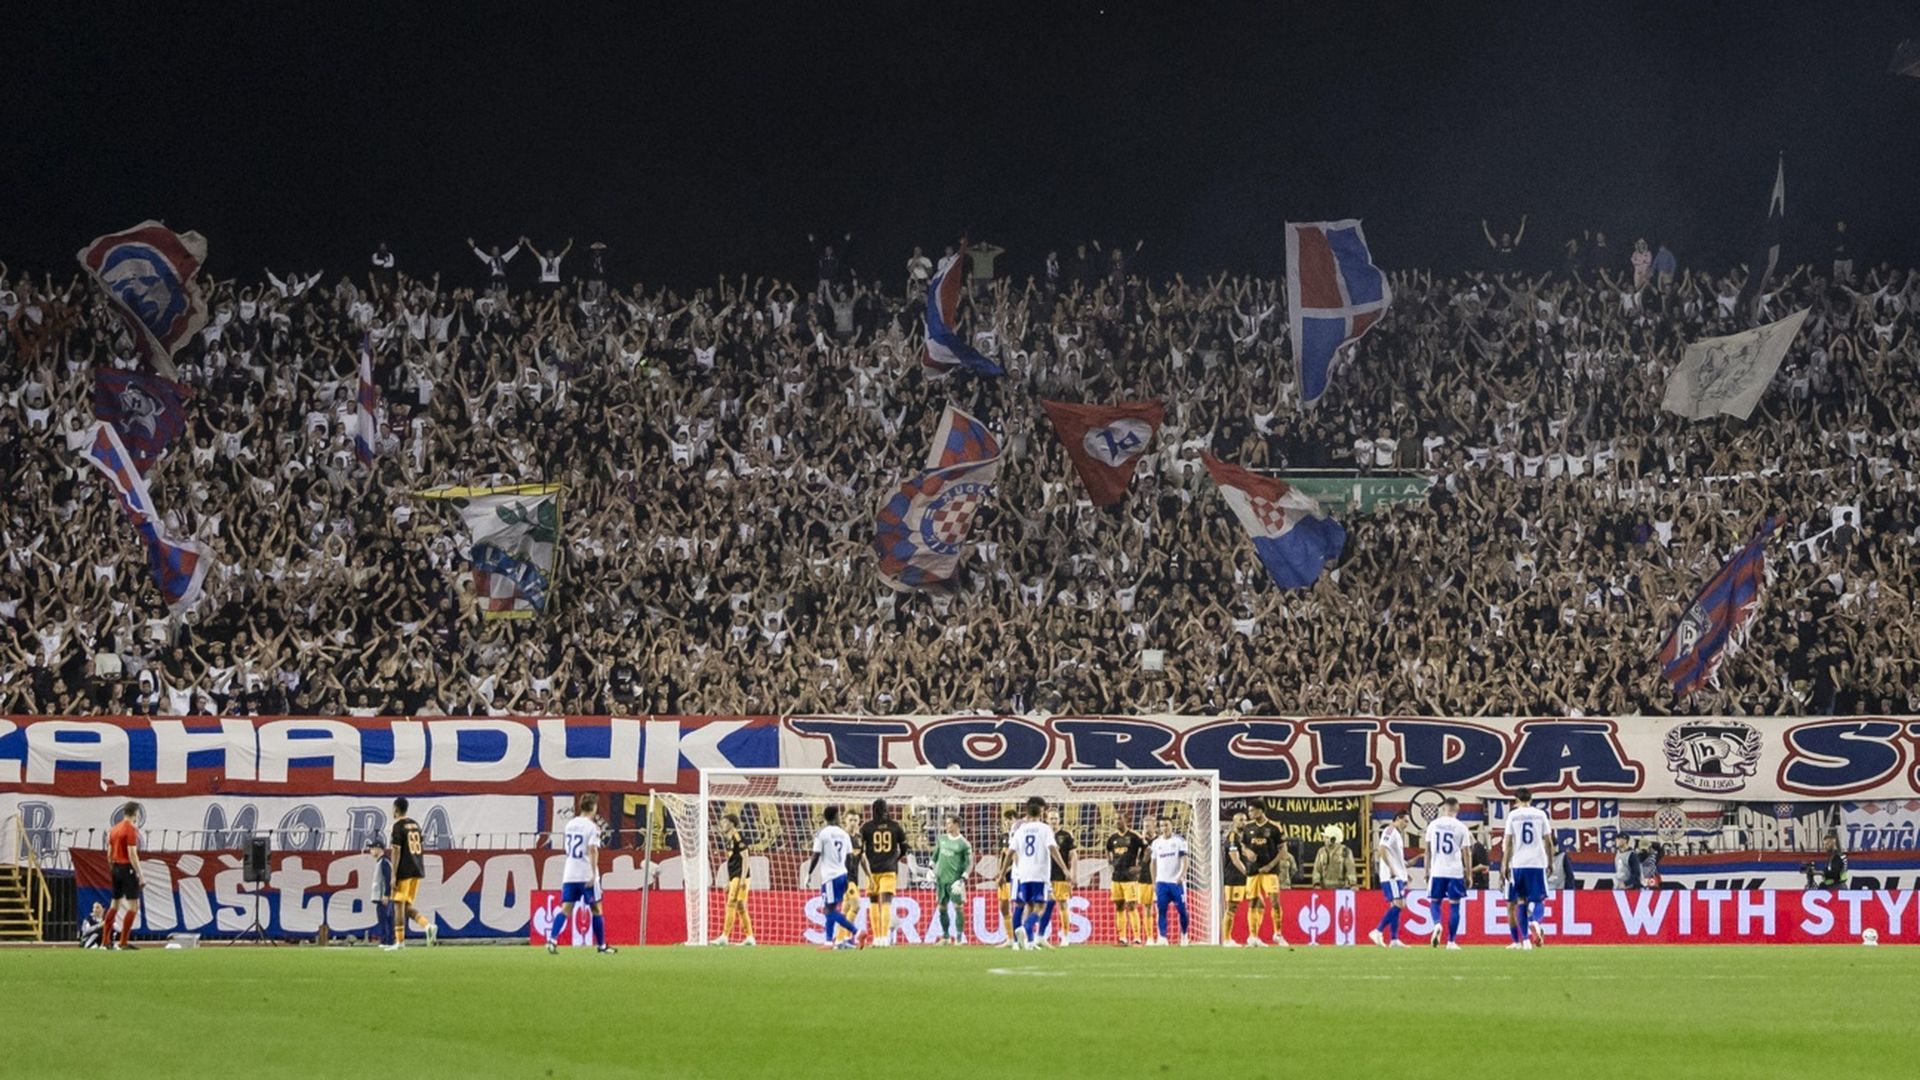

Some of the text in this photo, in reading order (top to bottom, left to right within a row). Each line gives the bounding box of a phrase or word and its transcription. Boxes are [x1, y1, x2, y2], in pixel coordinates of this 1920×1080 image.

[0, 718, 753, 784] A HAJDUK
[784, 716, 1645, 796] TORCIDA
[873, 831, 892, 853] 99
[1435, 832, 1453, 854] 15
[1522, 821, 1533, 845] 6
[834, 840, 843, 863] 7
[1026, 835, 1035, 857] 8
[1613, 889, 1775, 935] WITH
[1801, 889, 1919, 936] STY
